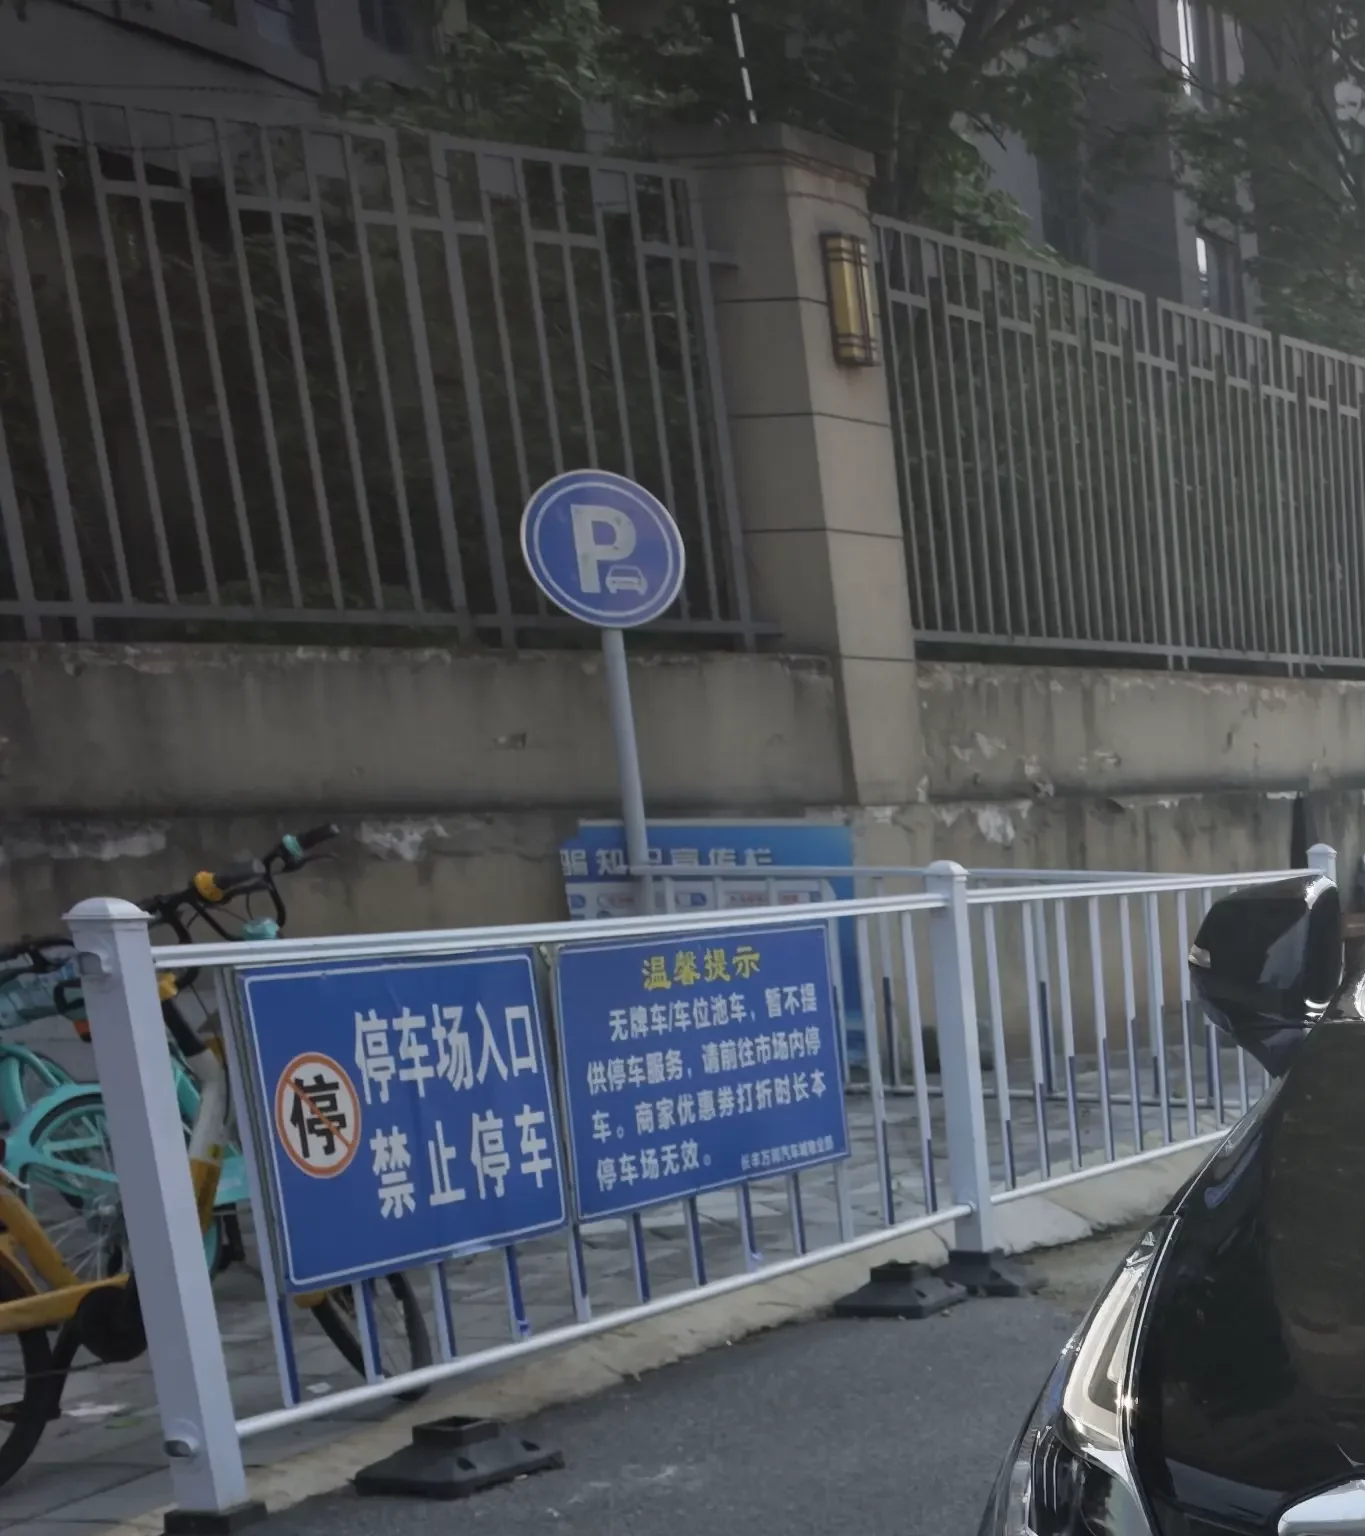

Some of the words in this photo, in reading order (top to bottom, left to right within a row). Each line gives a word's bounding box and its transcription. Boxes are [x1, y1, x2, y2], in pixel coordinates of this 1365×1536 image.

[569, 503, 637, 594] P
[641, 945, 761, 992] 温馨提示
[352, 1003, 539, 1106] 停车场入口
[289, 1072, 348, 1159] 停
[370, 1104, 554, 1221] 禁止停车
[596, 1138, 713, 1193] 停车场无效。
